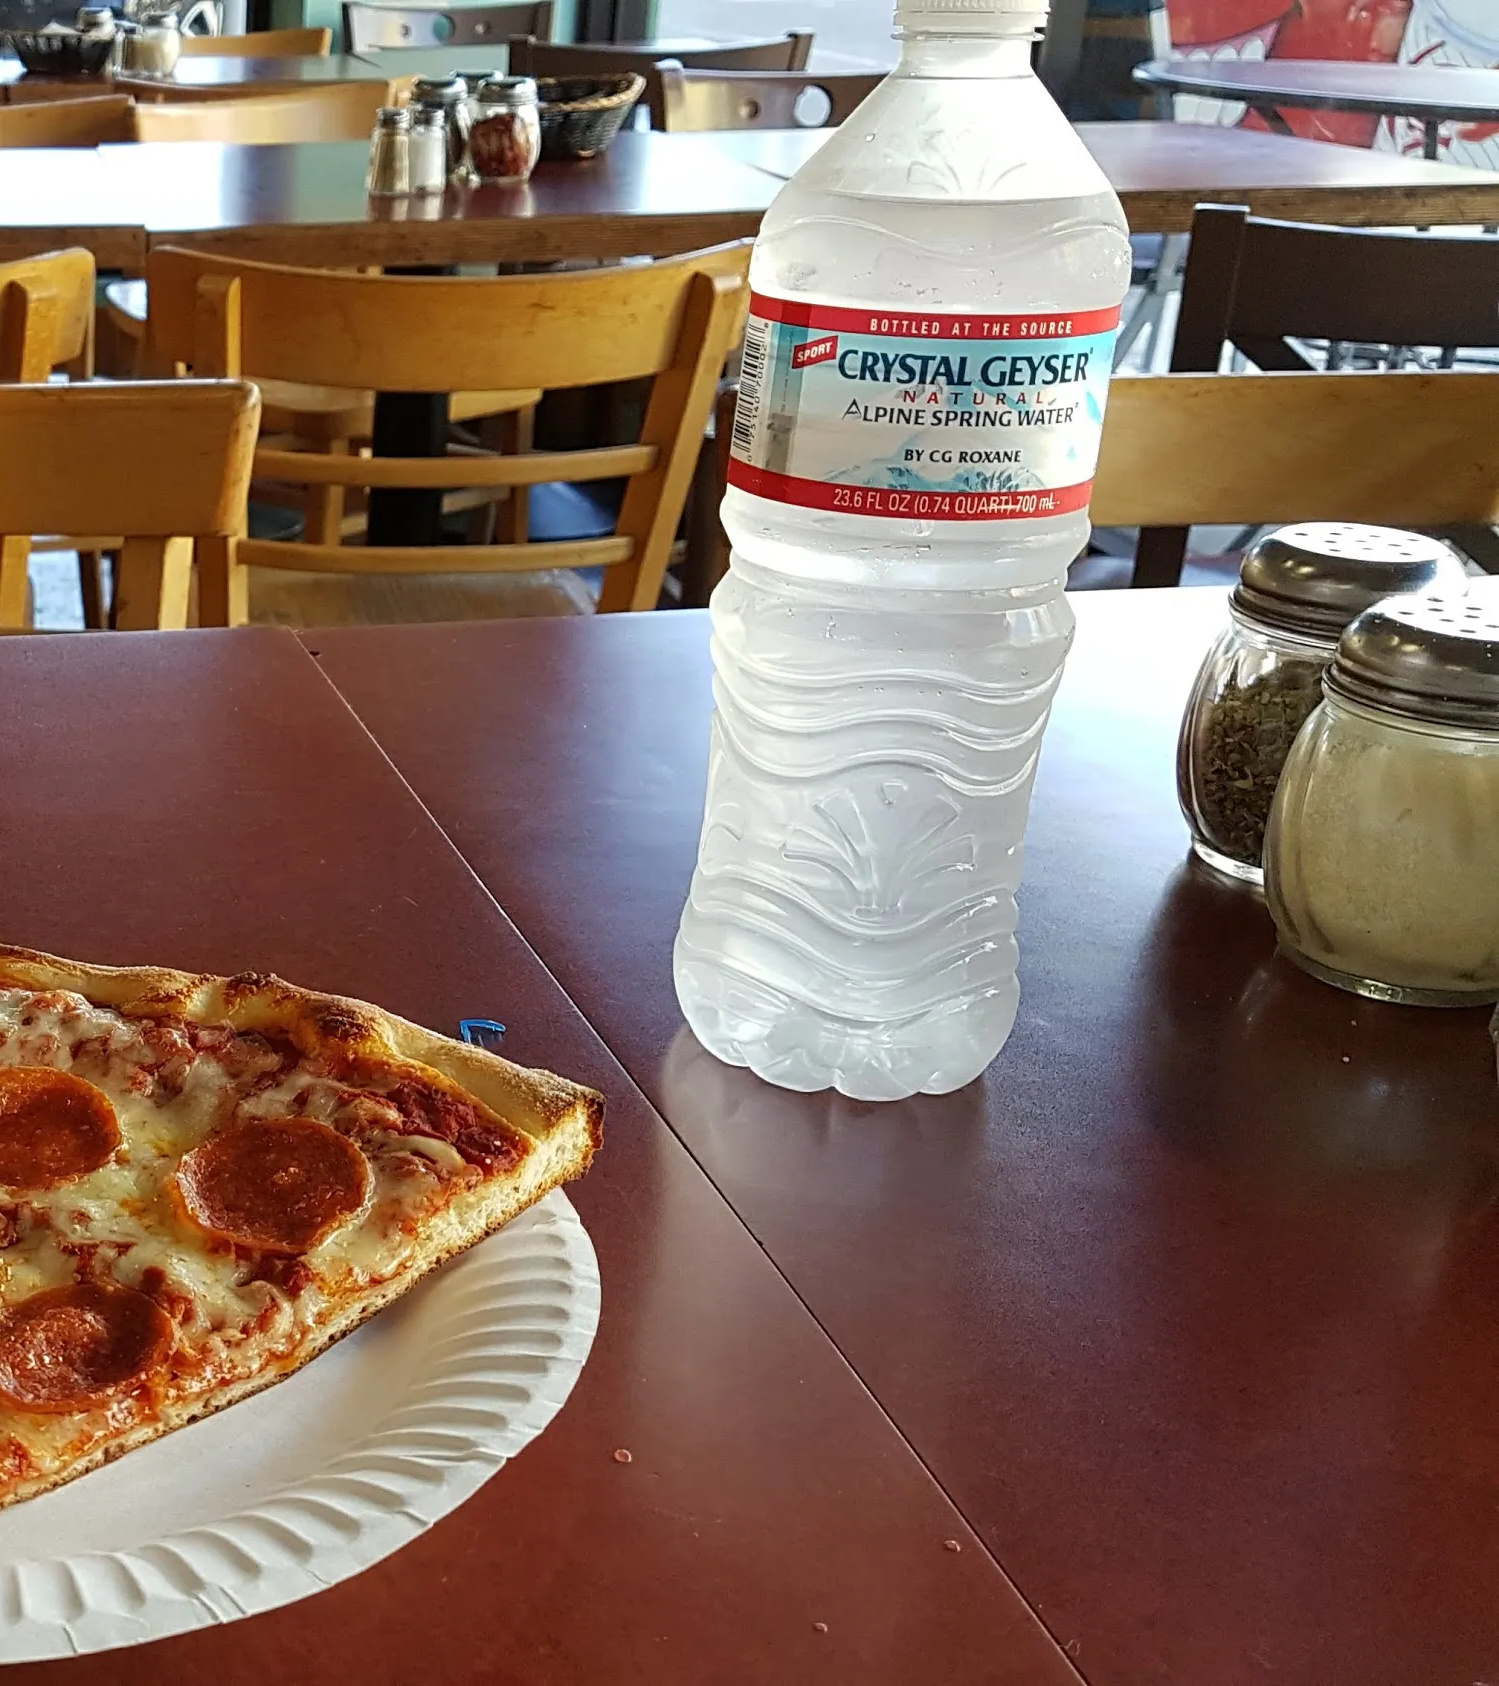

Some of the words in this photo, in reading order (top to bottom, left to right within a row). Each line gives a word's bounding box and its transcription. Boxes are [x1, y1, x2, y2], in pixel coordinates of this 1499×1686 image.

[870, 318, 939, 334] BOTTLED
[952, 322, 971, 335] AT
[983, 323, 1010, 336] THE
[1020, 320, 1073, 336] SOURCE
[797, 342, 833, 362] SPORT
[838, 348, 972, 386] CRYSTAL
[980, 352, 1089, 387] GEYSER
[903, 388, 1043, 405] NATURAL
[842, 398, 926, 426] ALPINE
[930, 410, 1012, 427] SPRING
[1017, 406, 1074, 426] WATER
[904, 449, 924, 462] BY
[929, 450, 952, 463] CG
[958, 450, 1021, 464] ROXANE
[833, 488, 862, 508] 23.6
[865, 491, 883, 510] FL
[888, 493, 910, 512] OZ
[914, 494, 950, 515] (0.74
